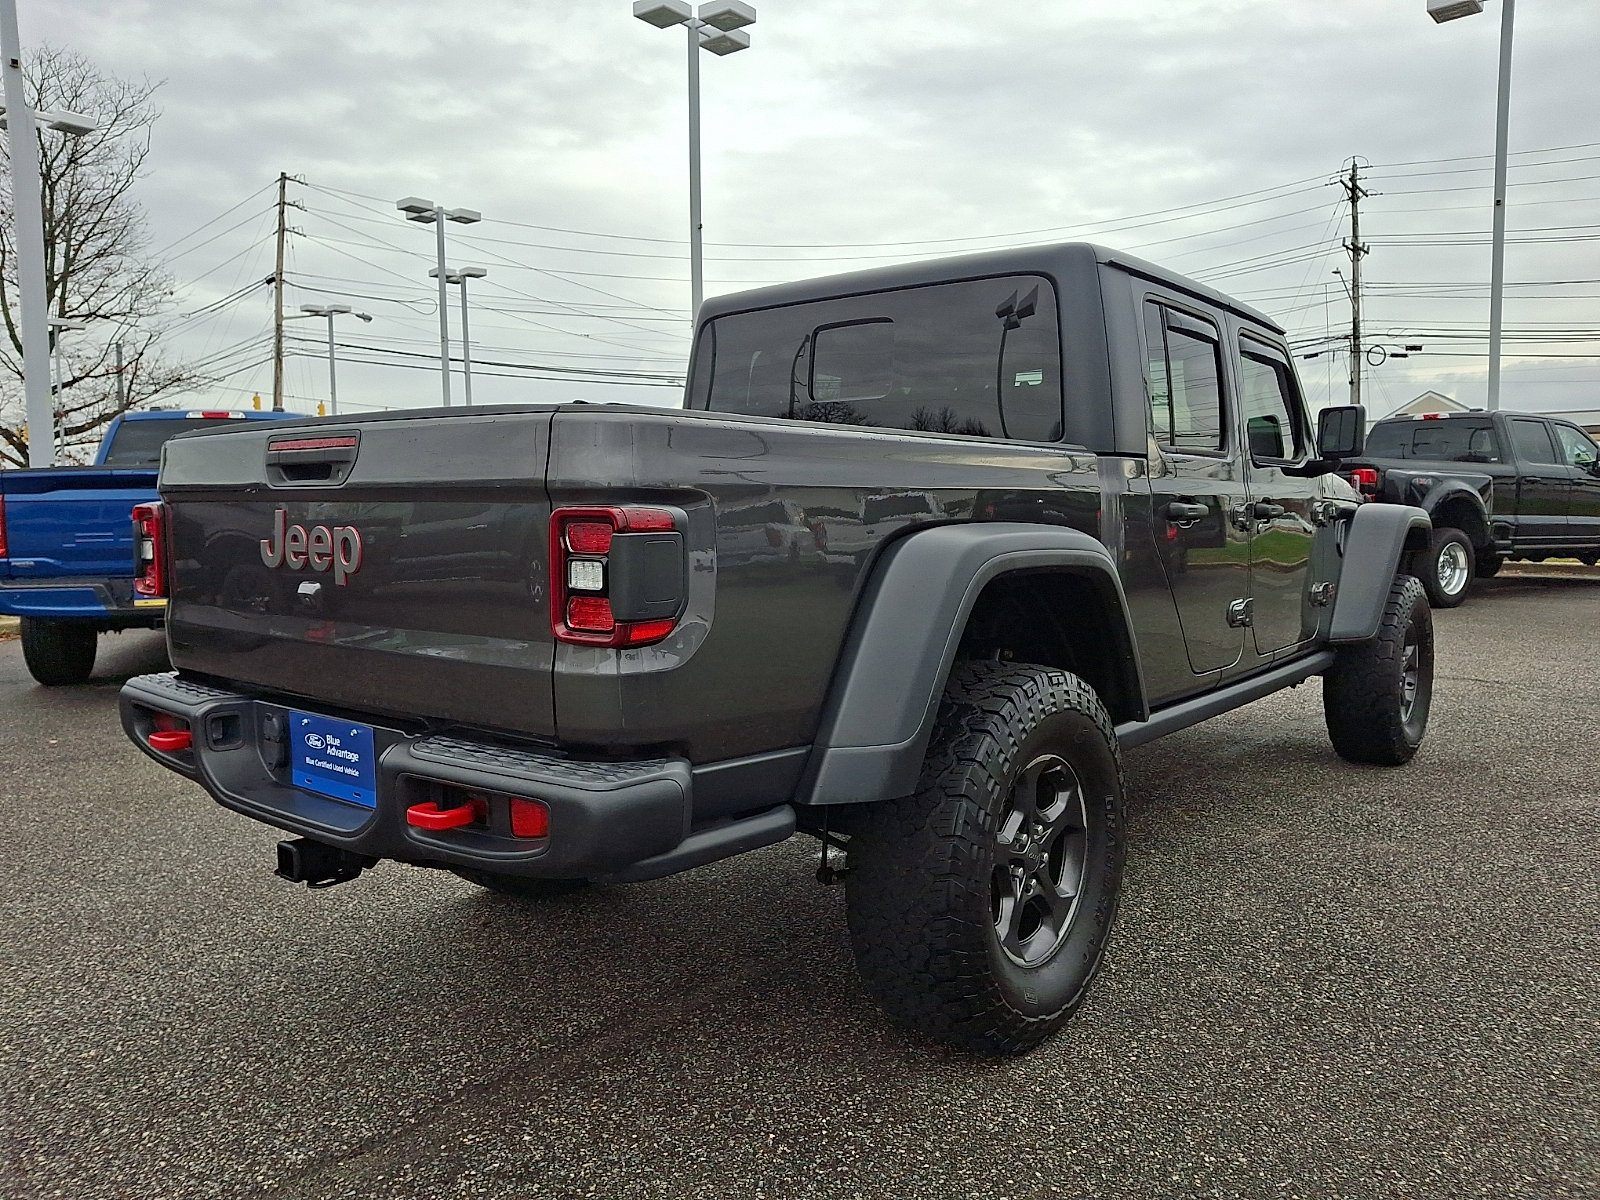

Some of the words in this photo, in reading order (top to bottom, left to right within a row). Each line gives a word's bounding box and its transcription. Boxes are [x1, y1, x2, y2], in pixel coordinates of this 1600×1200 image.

[260, 509, 363, 587] Jeep
[326, 734, 341, 746] Blue
[327, 746, 359, 762] Advantage
[305, 756, 315, 766] Blue
[314, 759, 333, 770] Certified
[332, 763, 344, 773] Used
[344, 766, 360, 777] Vehicle
